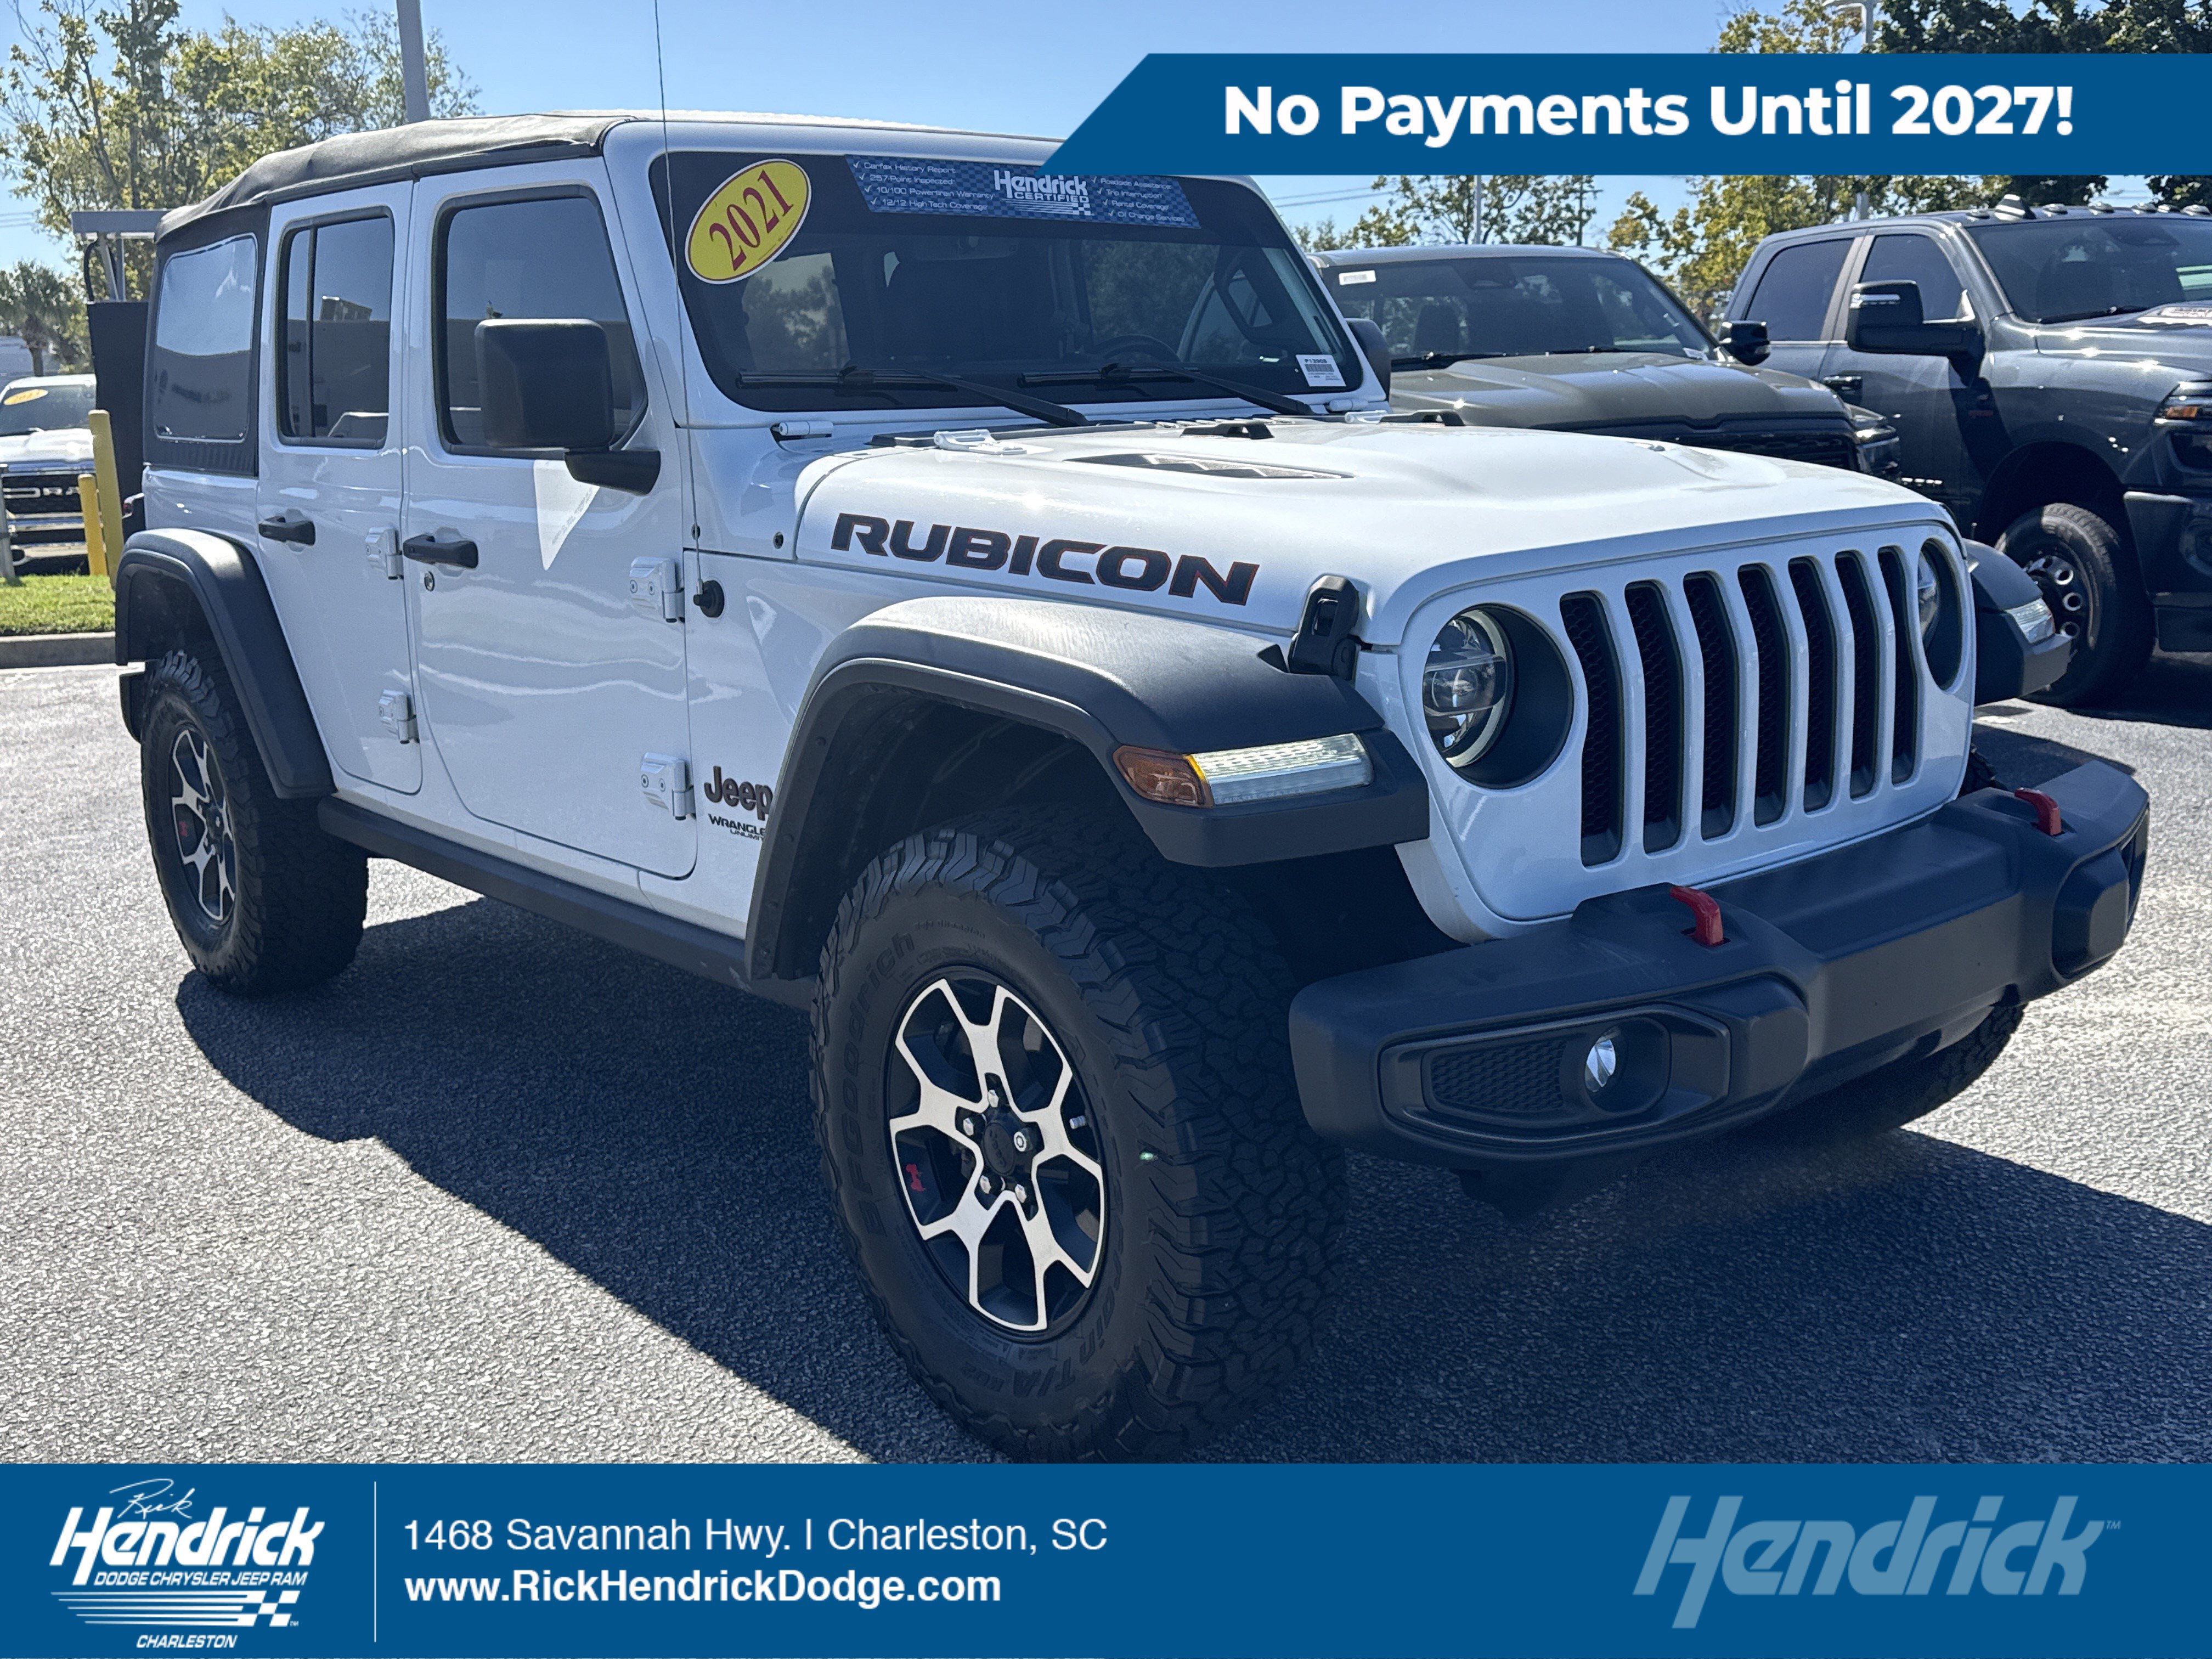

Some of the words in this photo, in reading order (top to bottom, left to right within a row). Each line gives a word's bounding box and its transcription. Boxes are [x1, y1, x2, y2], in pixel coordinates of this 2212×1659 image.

[927, 166, 956, 174] Report
[877, 187, 907, 195] 10/100
[994, 170, 1088, 199] Hendrick
[882, 198, 907, 207] 12/12
[1015, 192, 1090, 204] CERTIFIED
[709, 169, 794, 271] 2021
[831, 512, 1260, 606] RUBICON
[704, 765, 774, 821] Jeep
[708, 813, 766, 836] WRANGLE
[730, 828, 764, 841] UNLIMIT
